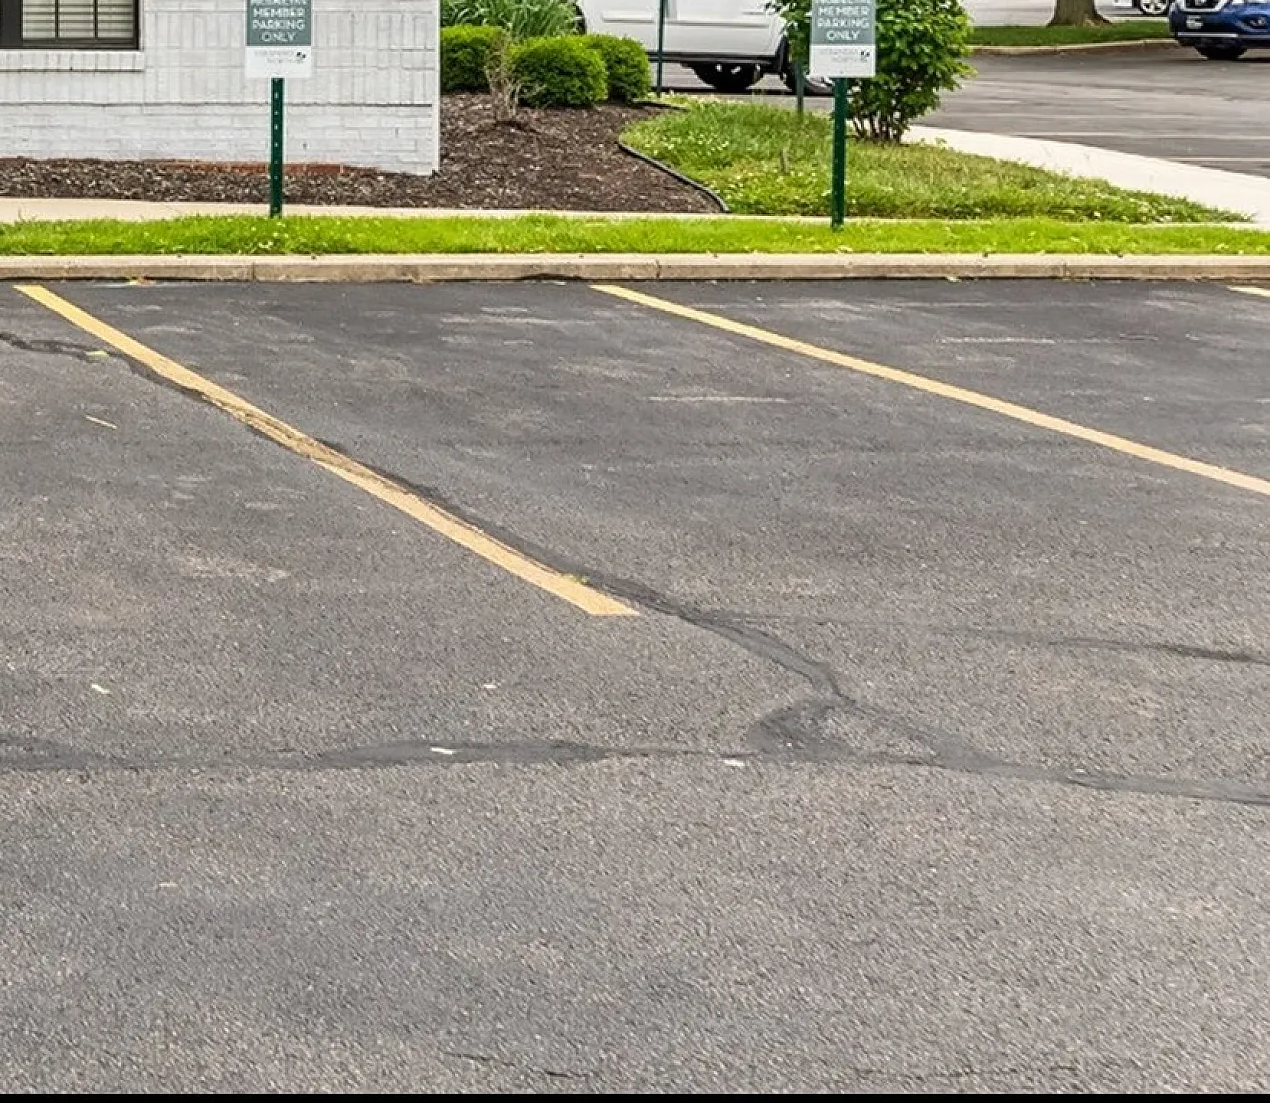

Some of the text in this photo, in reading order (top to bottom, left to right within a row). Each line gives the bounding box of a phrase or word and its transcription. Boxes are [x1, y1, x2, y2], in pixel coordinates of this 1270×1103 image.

[253, 7, 306, 18] MEMBER
[817, 6, 870, 16] MEMBER
[252, 19, 306, 30] PARKING
[817, 17, 870, 28] PARKING
[261, 31, 296, 42] ONLY
[826, 29, 860, 41] ONLY
